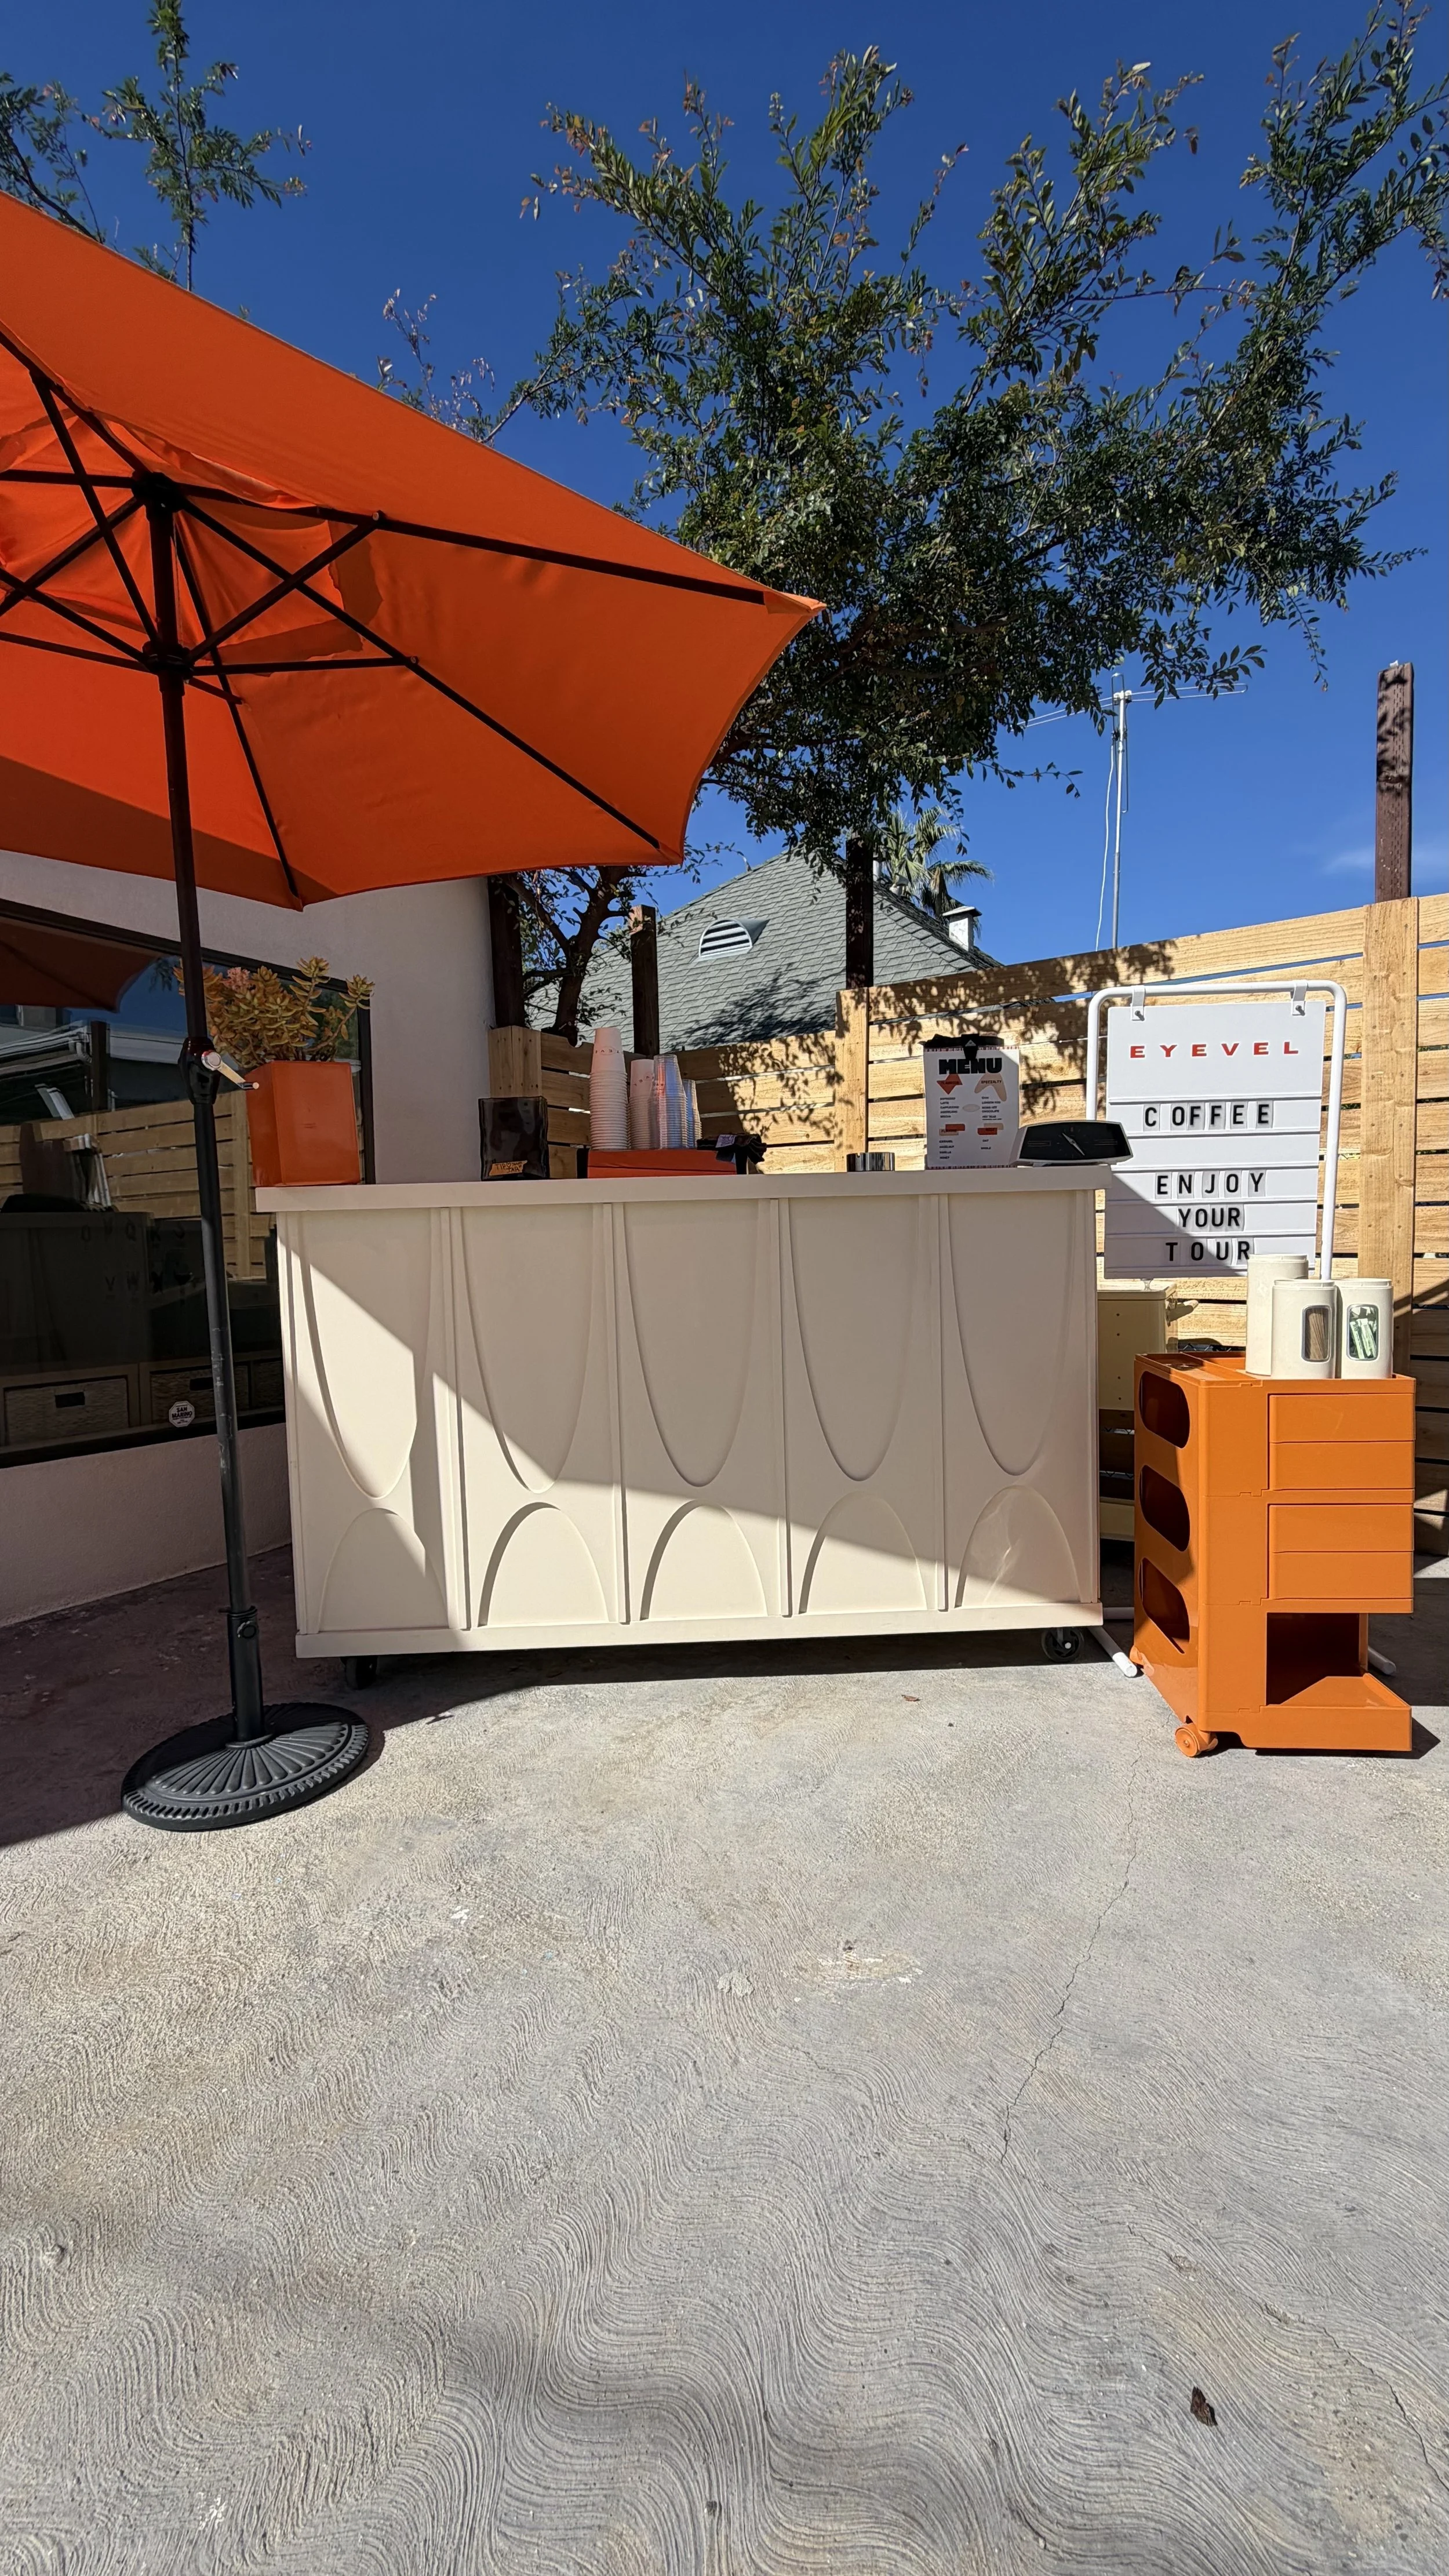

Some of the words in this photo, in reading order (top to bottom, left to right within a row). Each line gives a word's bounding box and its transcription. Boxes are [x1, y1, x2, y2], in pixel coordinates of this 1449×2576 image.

[1130, 1041, 1299, 1058] EYEVEL
[938, 1057, 1003, 1075] MENU
[1144, 1104, 1269, 1126] COFFEE
[1157, 1173, 1264, 1195] ENJOY
[1178, 1206, 1240, 1228] YOUR
[1165, 1240, 1251, 1262] TOUR
